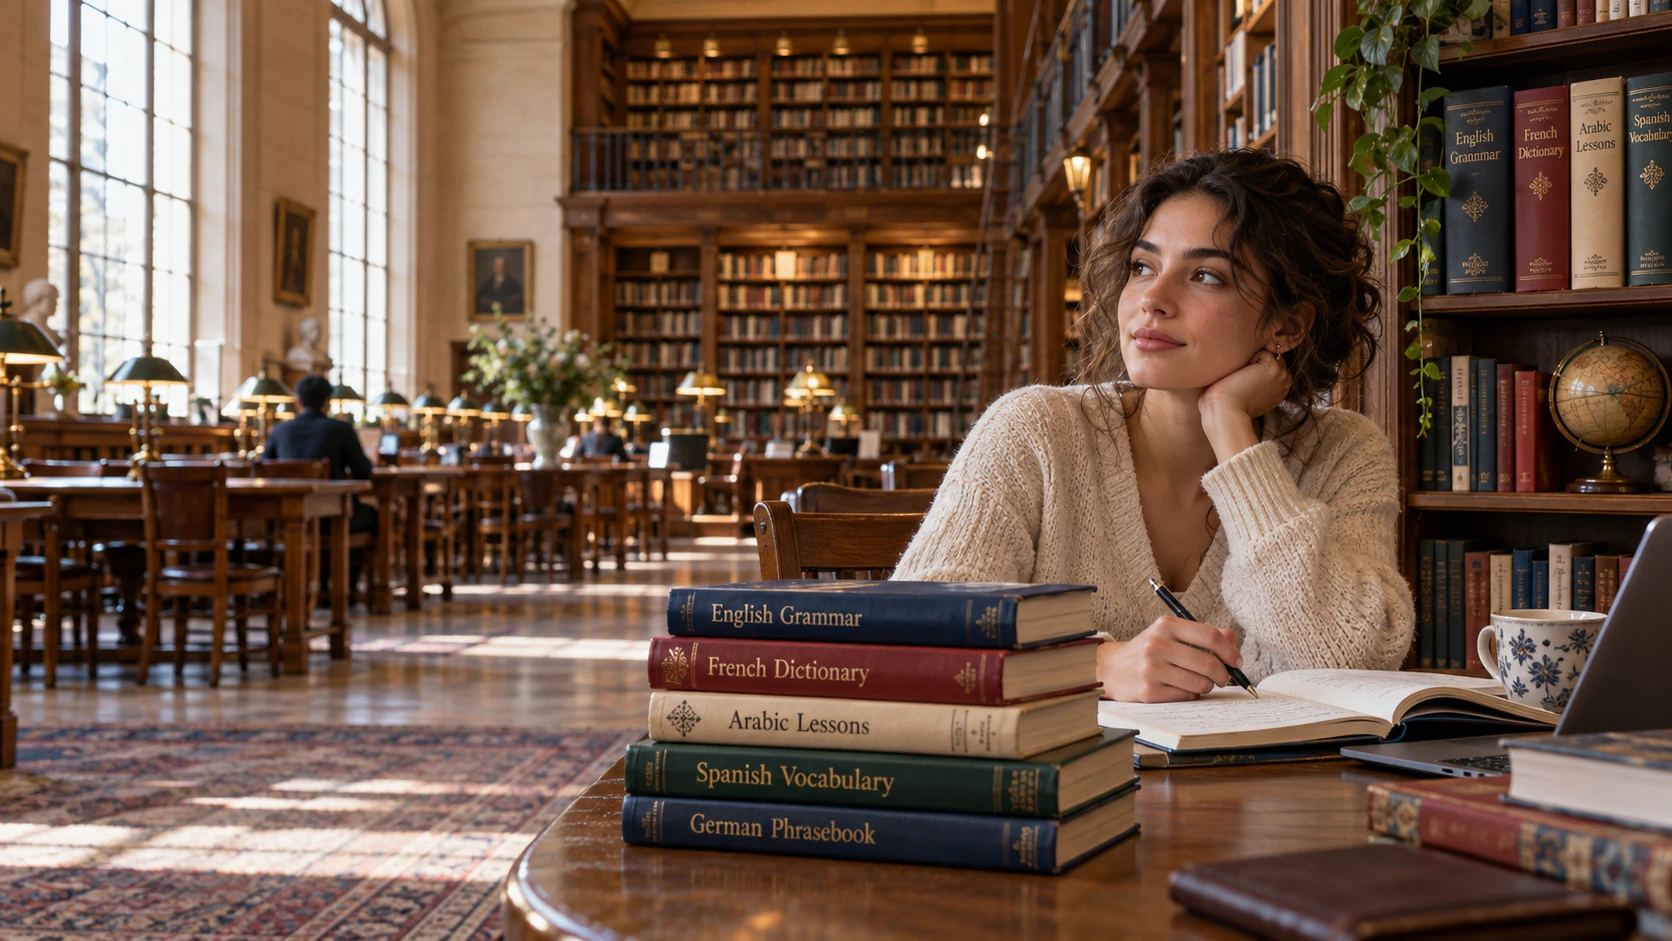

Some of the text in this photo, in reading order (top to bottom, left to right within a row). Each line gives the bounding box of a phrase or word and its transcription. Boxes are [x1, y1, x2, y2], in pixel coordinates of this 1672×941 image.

[1579, 120, 1612, 135] Arabic
[1634, 110, 1670, 128] Spanish
[1456, 129, 1494, 147] English
[1524, 126, 1558, 141] French
[1518, 145, 1564, 159] Dictionary
[1576, 139, 1616, 153] Lessons
[711, 603, 774, 629] English
[780, 605, 862, 627] Grammar
[708, 656, 869, 687] French Dictionary
[728, 710, 870, 735] Arabic Lessons
[696, 761, 772, 789] Spanish
[780, 765, 895, 798] Vocabulary
[690, 813, 762, 837] German
[771, 817, 876, 845] Phrasebook
